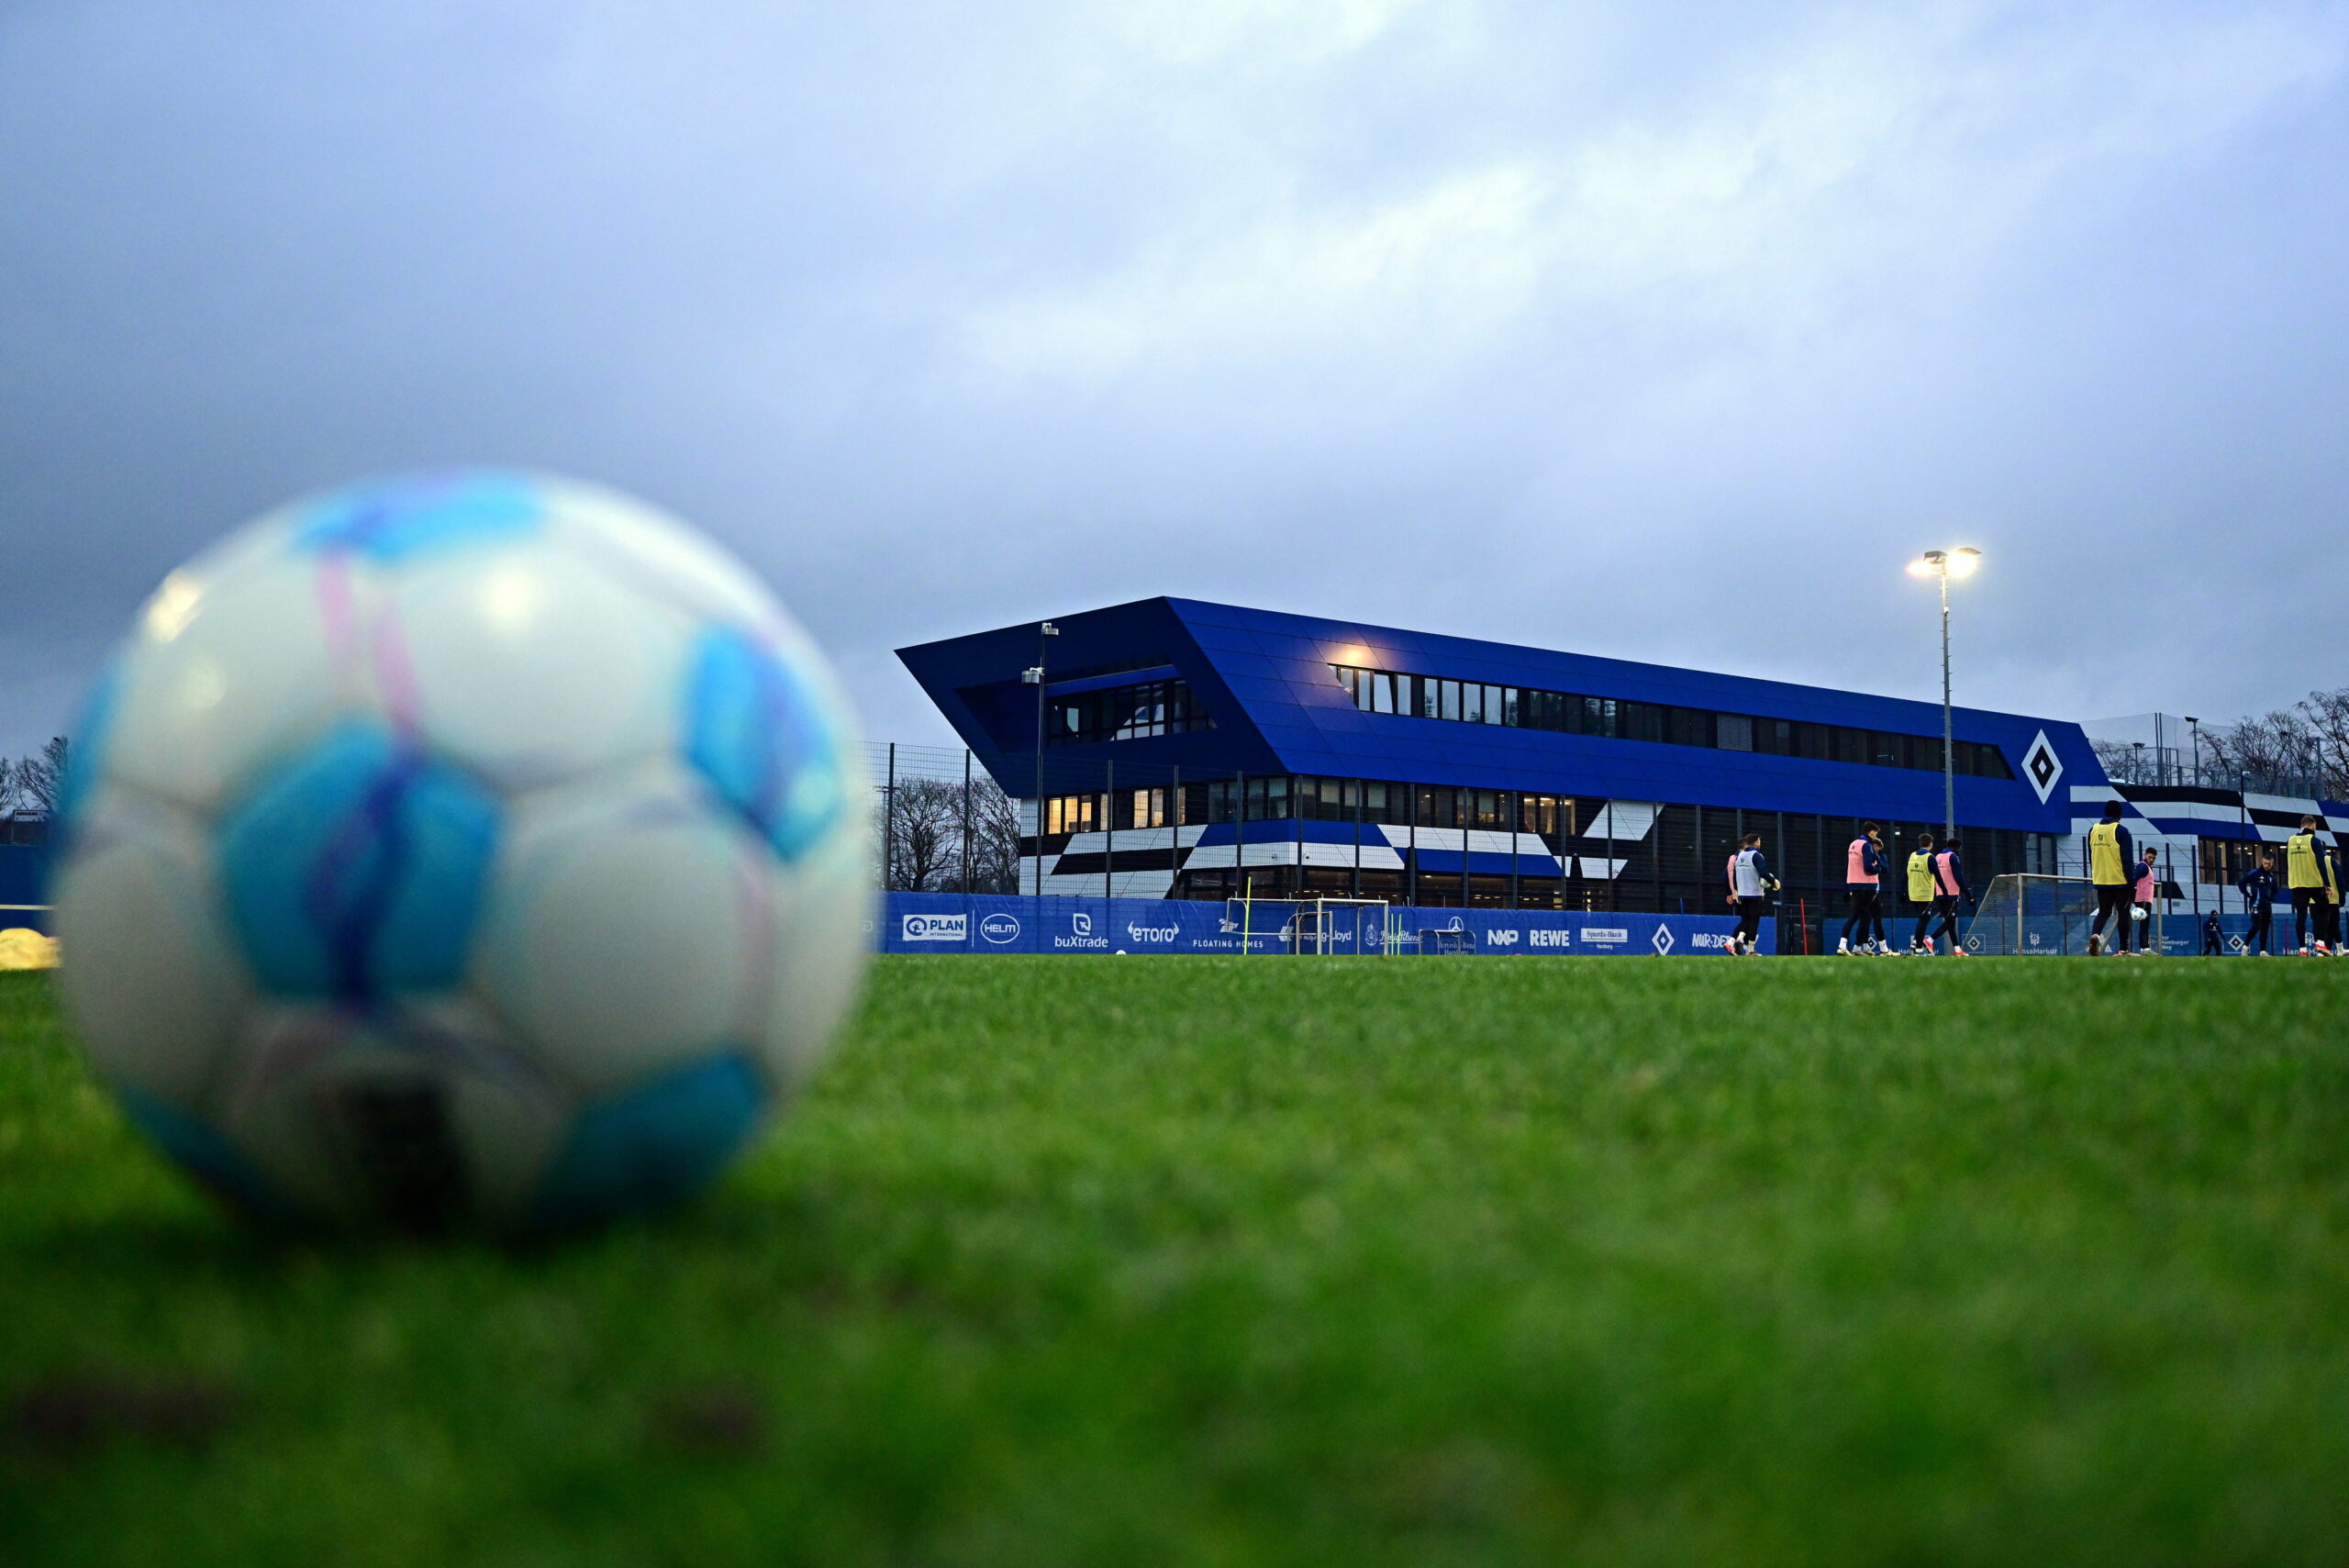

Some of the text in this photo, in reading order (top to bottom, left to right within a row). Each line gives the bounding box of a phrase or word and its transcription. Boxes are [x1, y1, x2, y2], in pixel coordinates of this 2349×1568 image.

[930, 919, 963, 931] PLAN
[984, 924, 1017, 933] HELM
[1487, 929, 1519, 946] NXP
[1530, 929, 1570, 947] REWE
[1586, 930, 1622, 939] Sparda-Bank
[1054, 935, 1108, 948] buXtrade
[1193, 940, 1264, 949] FLOATING HOMES
